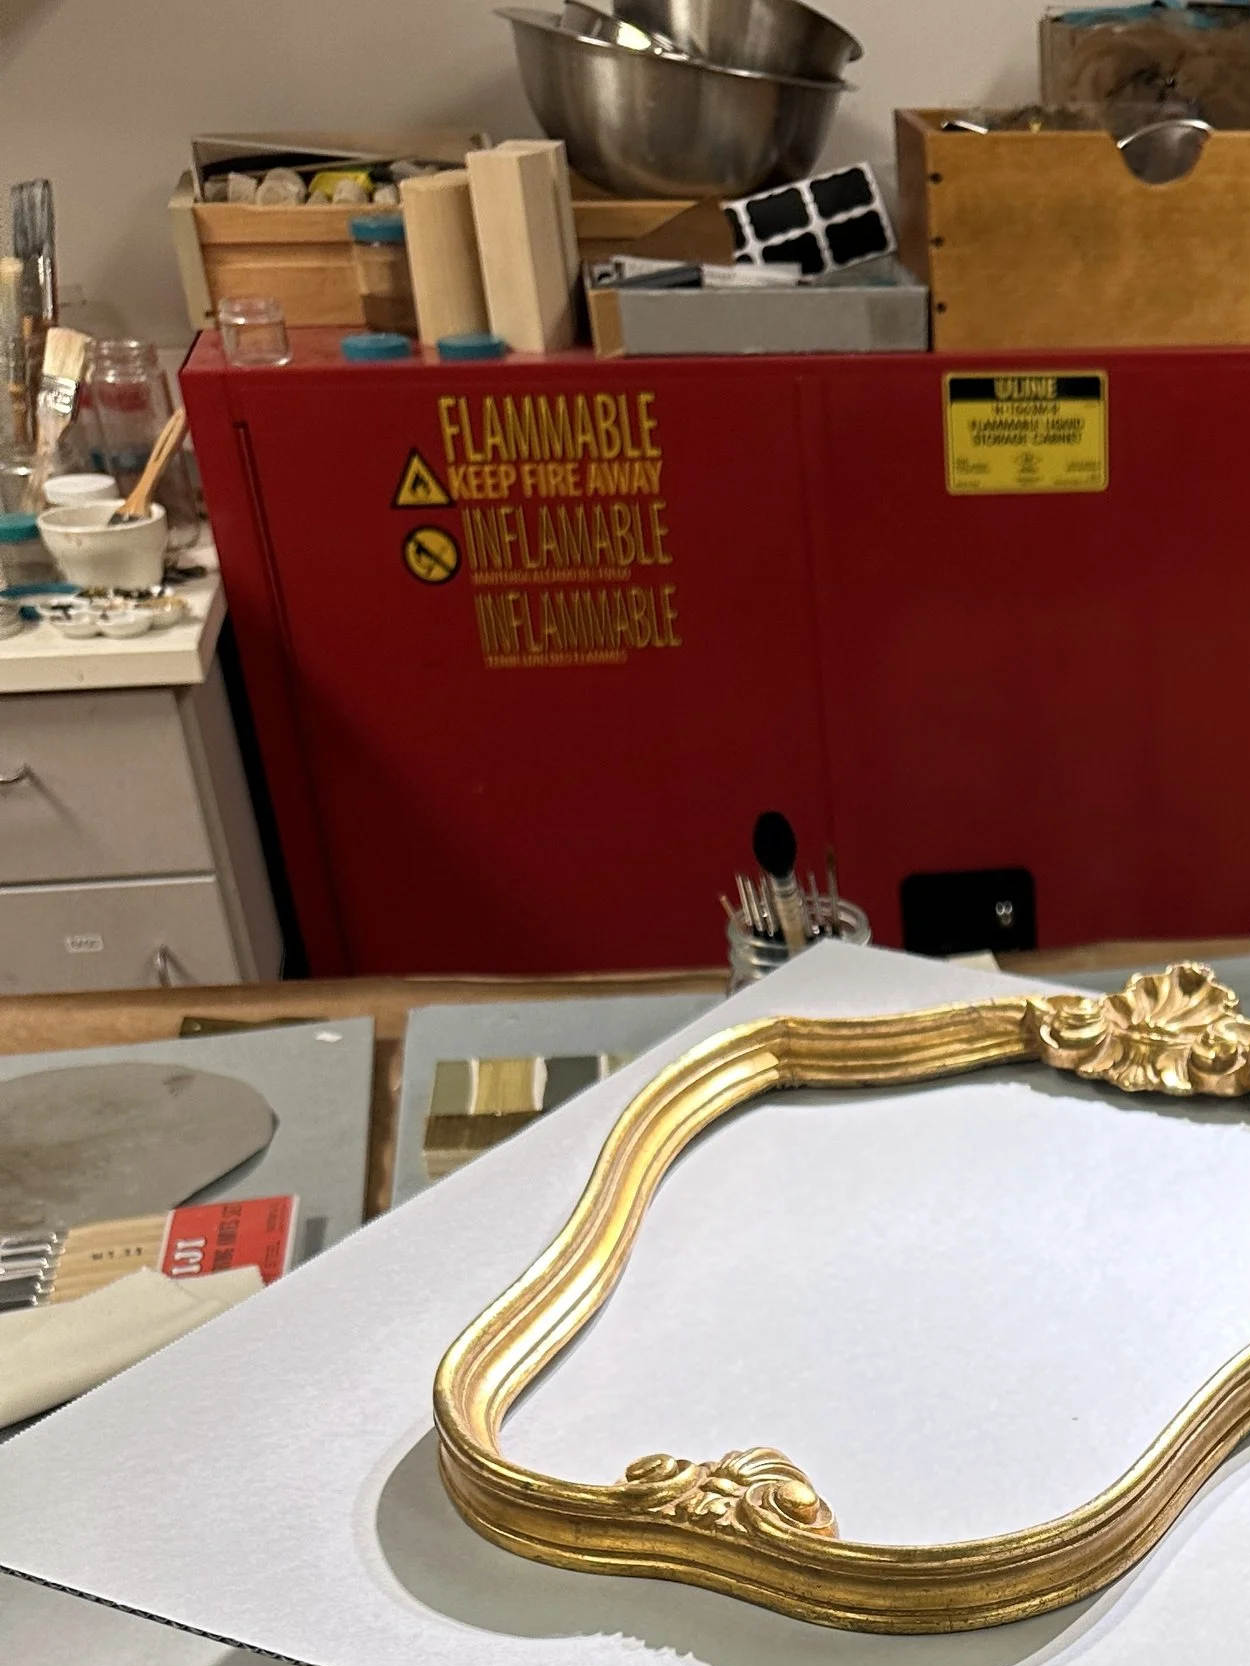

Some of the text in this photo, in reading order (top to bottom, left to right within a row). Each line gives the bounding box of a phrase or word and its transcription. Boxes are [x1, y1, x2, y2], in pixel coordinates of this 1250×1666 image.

[994, 377, 1058, 399] ULINE
[437, 391, 662, 464] FLAMMABLE
[449, 459, 663, 500] KEEP FIRE AWAY
[461, 501, 674, 570] INFLAMABLE
[474, 584, 683, 654] INFLAMMABLE
